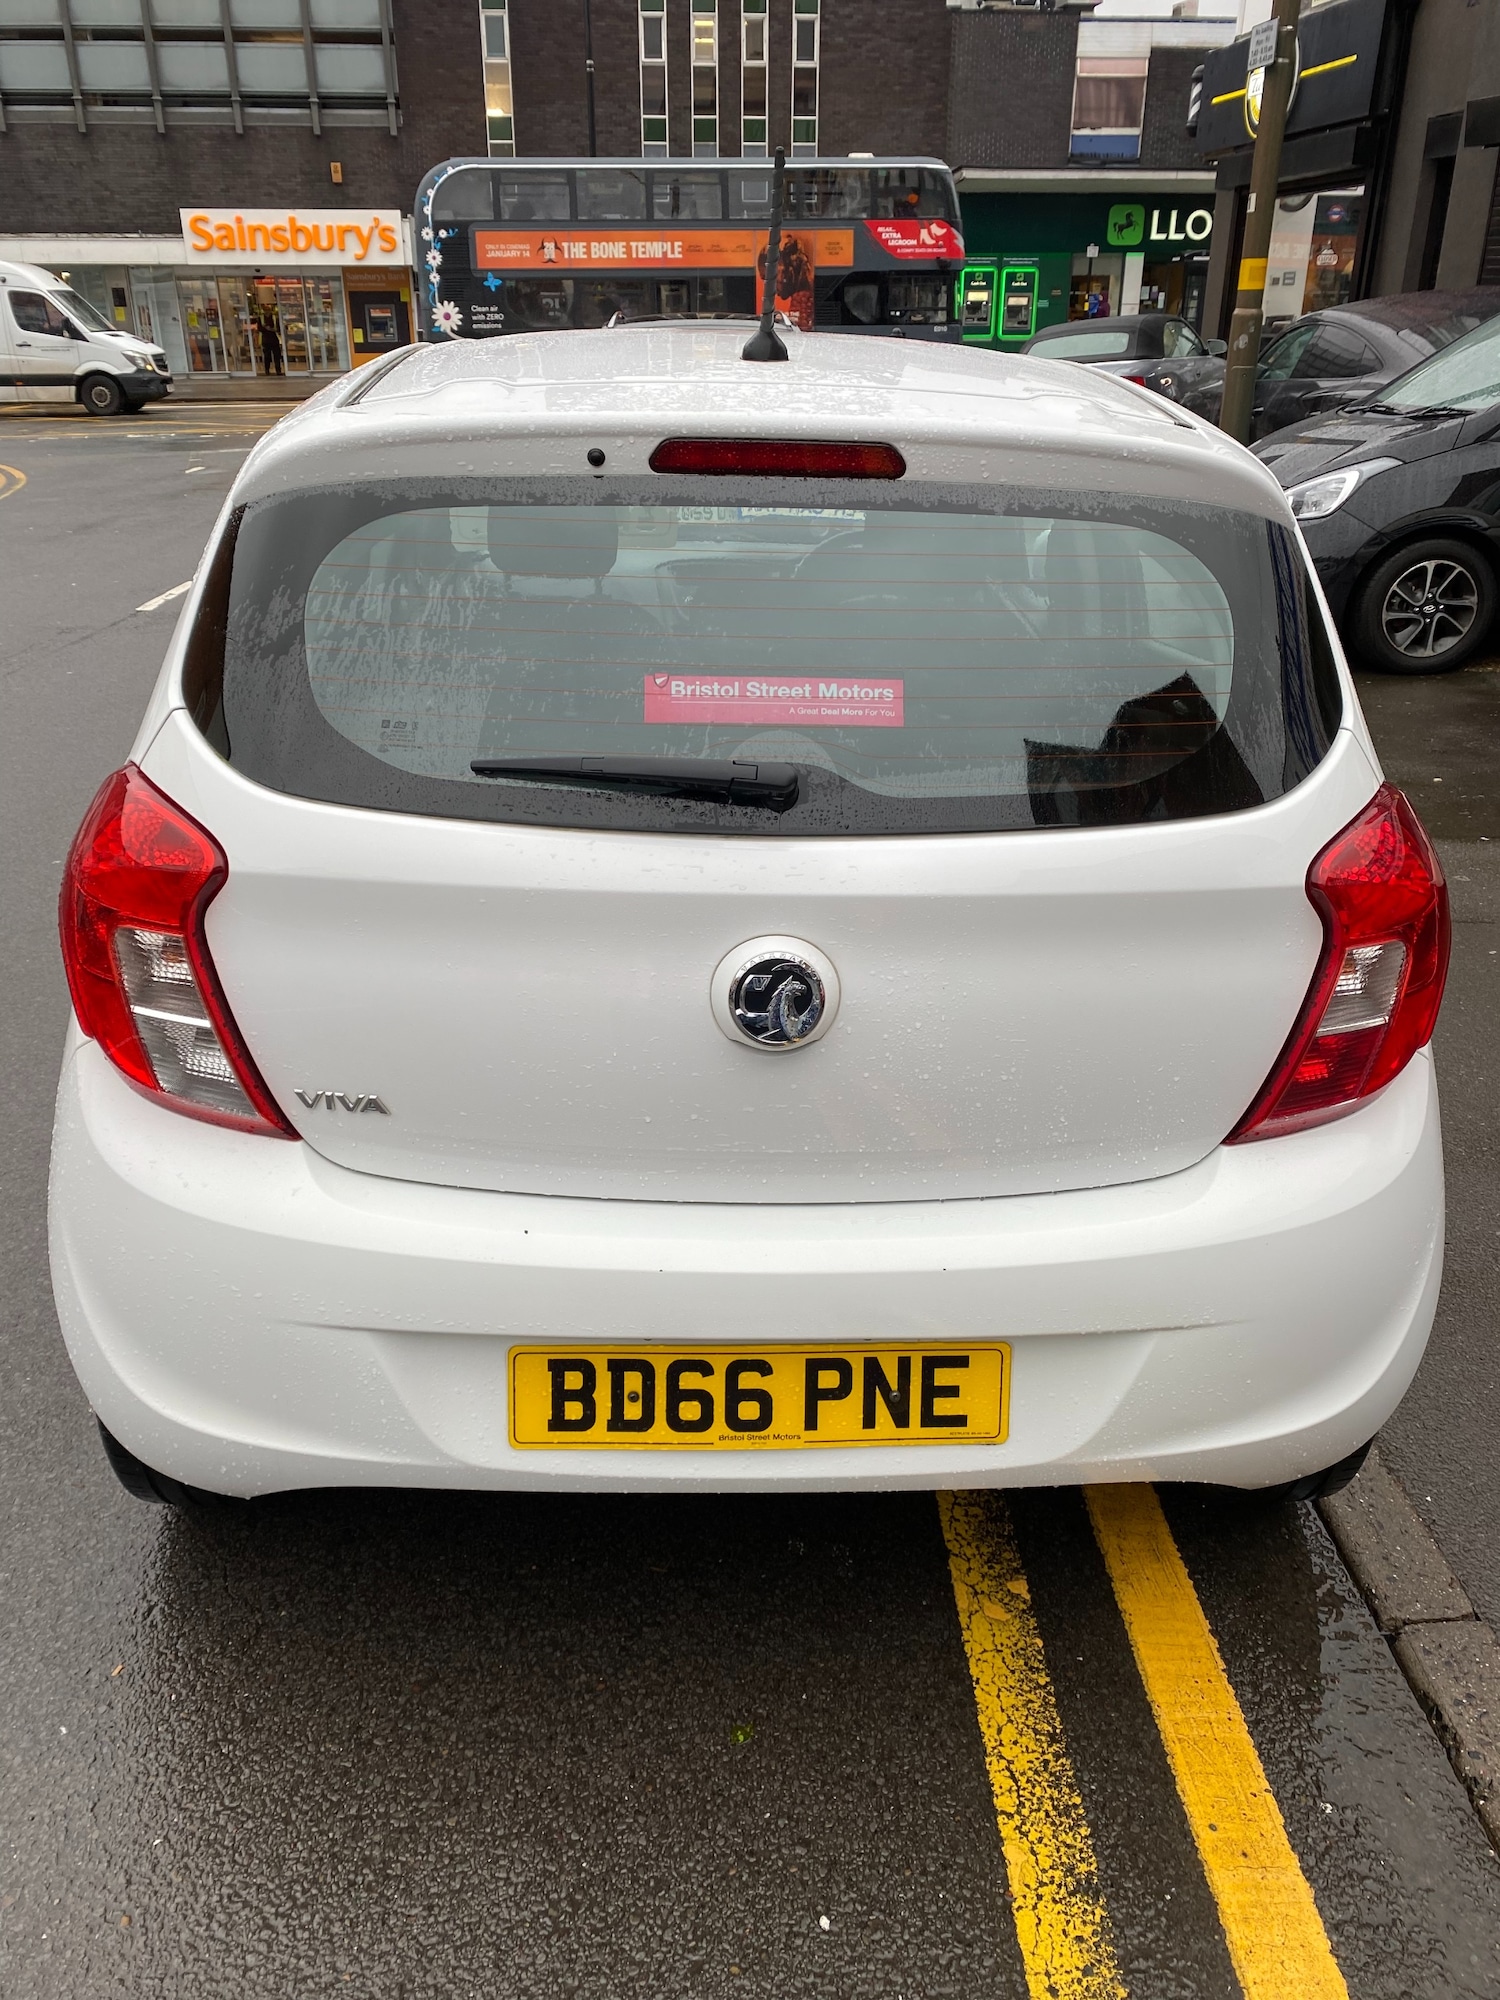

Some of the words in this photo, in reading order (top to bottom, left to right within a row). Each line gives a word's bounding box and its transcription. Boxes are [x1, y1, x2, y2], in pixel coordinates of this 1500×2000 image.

[189, 214, 397, 260] Sainsbury's
[1150, 209, 1215, 241] LLO
[562, 242, 588, 259] THE
[591, 242, 627, 259] BONE
[630, 242, 683, 259] TEMPLE
[670, 680, 739, 698] Bristol
[746, 681, 811, 699] Street
[818, 683, 894, 701] Motors
[797, 707, 819, 715] Great
[820, 707, 840, 715] Deal
[841, 707, 863, 716] More
[865, 708, 878, 716] For
[879, 708, 896, 717] You
[293, 1088, 391, 1115] VIVA
[547, 1358, 773, 1433] BD66
[804, 1355, 970, 1431] PNE
[746, 1433, 770, 1441] Street
